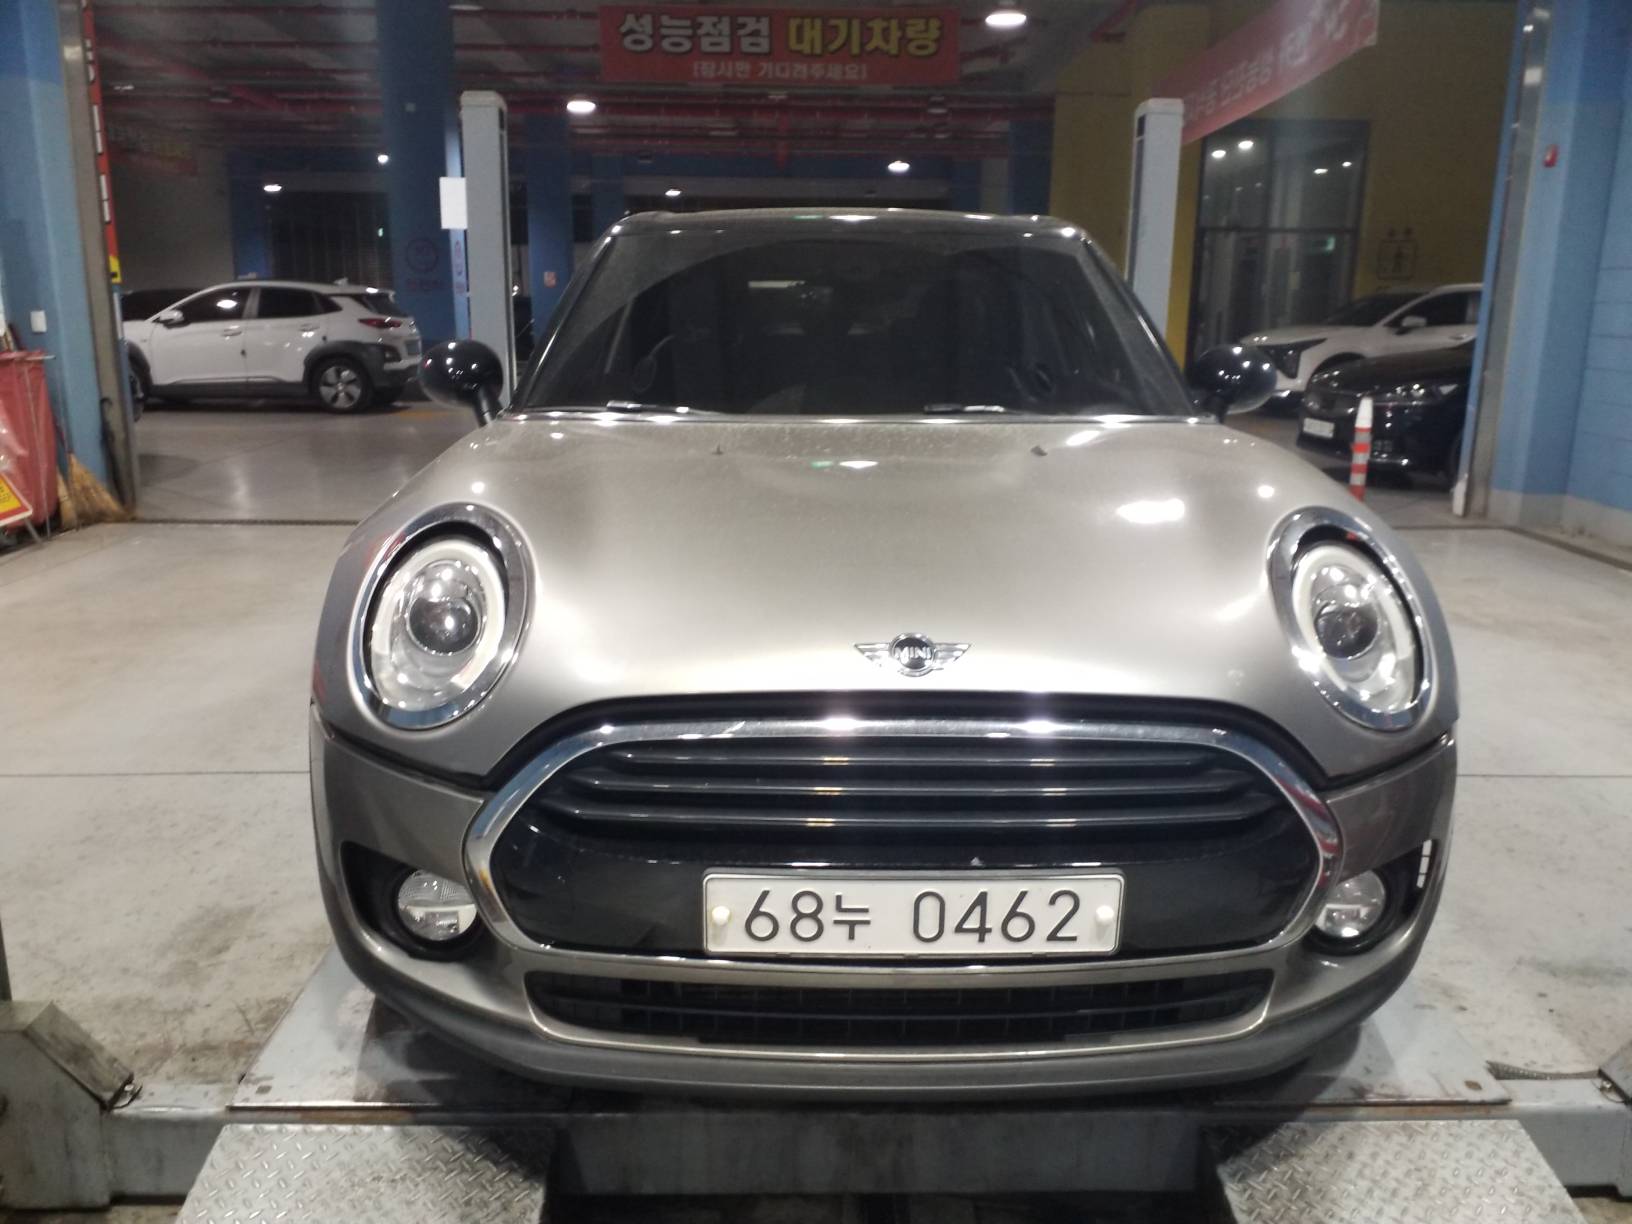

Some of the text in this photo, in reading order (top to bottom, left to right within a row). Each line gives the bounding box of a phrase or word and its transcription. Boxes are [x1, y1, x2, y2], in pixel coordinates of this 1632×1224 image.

[619, 13, 943, 57] 성능점검 대기차량
[894, 645, 932, 661] MINI
[744, 889, 1081, 943] 68누 0462
